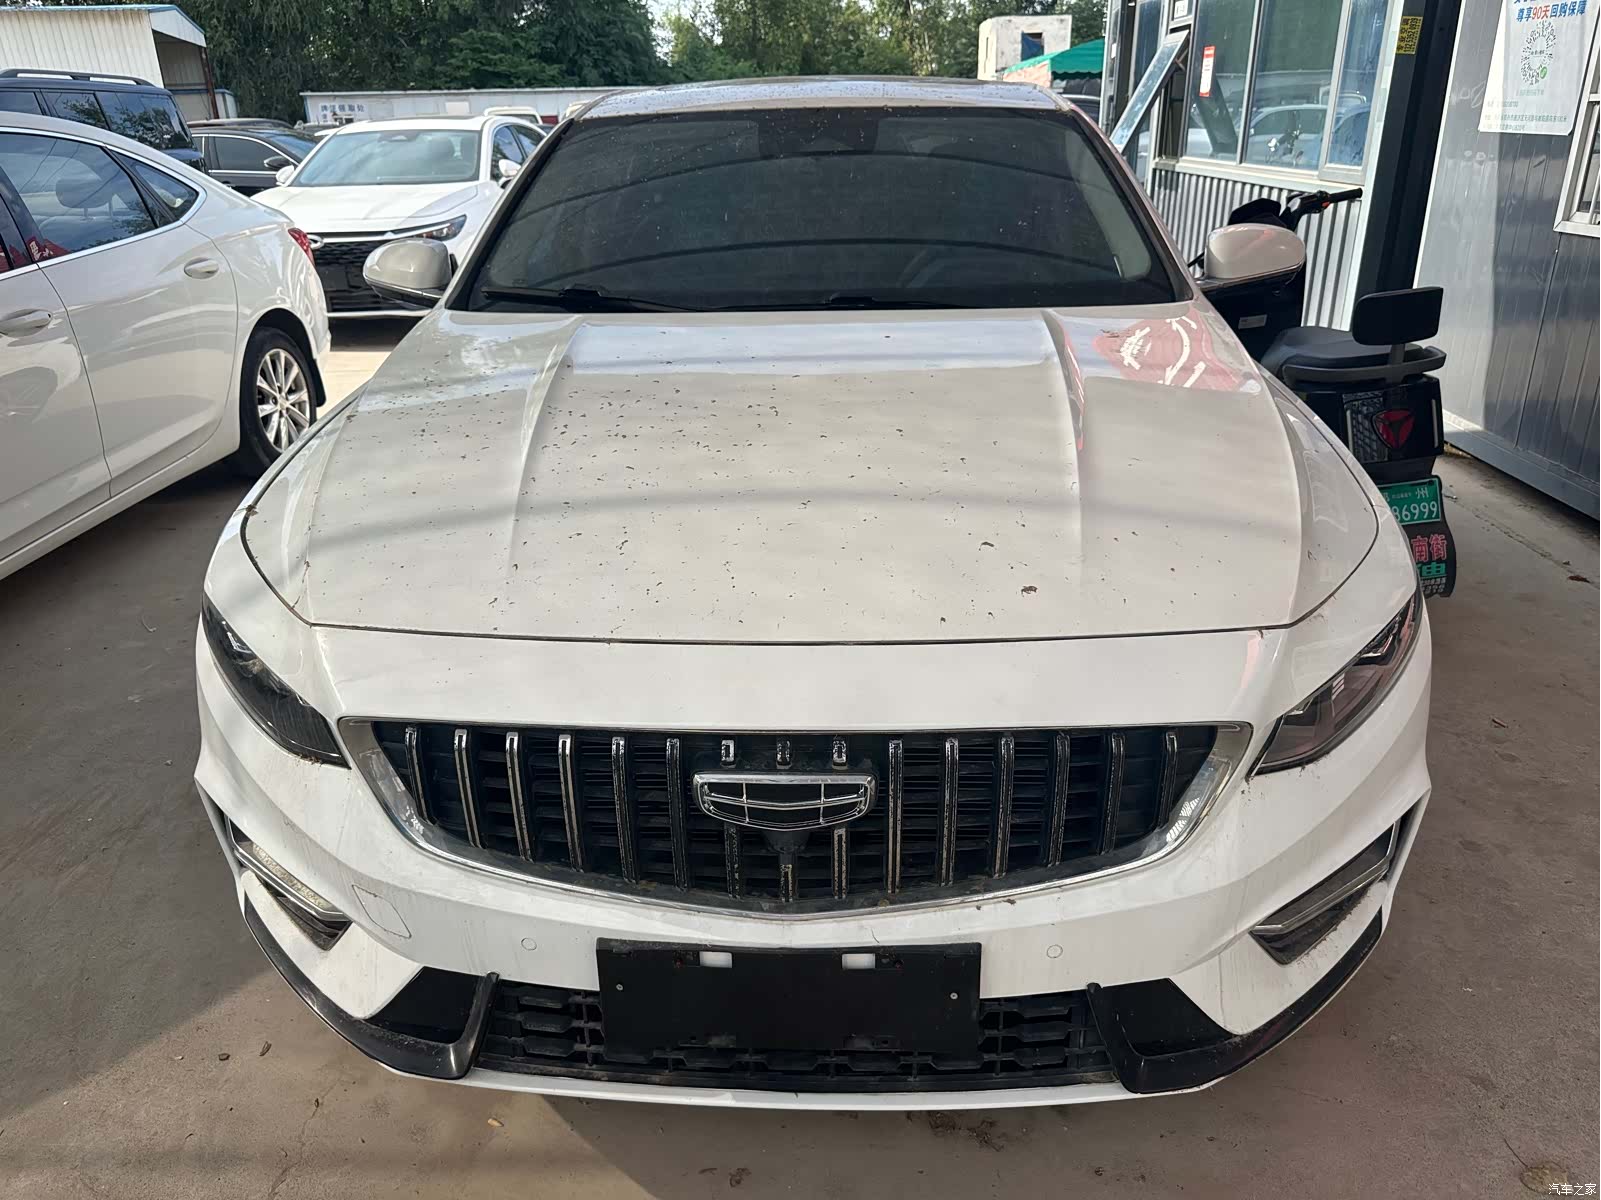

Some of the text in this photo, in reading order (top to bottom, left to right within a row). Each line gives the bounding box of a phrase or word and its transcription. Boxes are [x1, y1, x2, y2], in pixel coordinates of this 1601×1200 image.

[1516, 0, 1587, 22] 尊享90天回购保障
